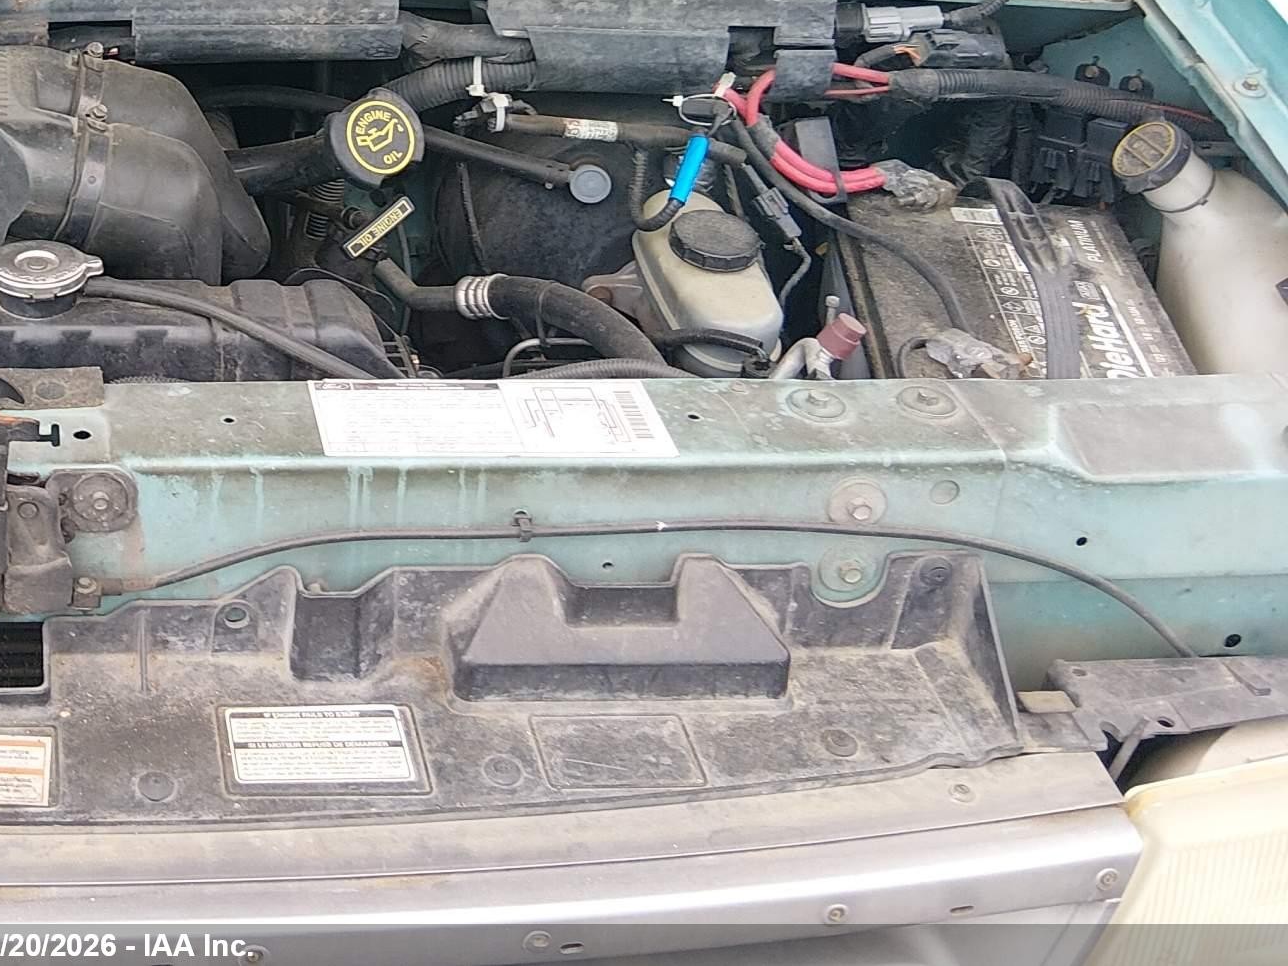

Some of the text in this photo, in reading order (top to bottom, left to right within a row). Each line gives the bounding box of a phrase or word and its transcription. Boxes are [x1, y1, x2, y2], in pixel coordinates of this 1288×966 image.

[355, 109, 392, 135] ENGINE
[383, 150, 403, 165] OIL
[360, 208, 404, 247] ENGINE OIL
[1067, 219, 1105, 263] PLATINUM
